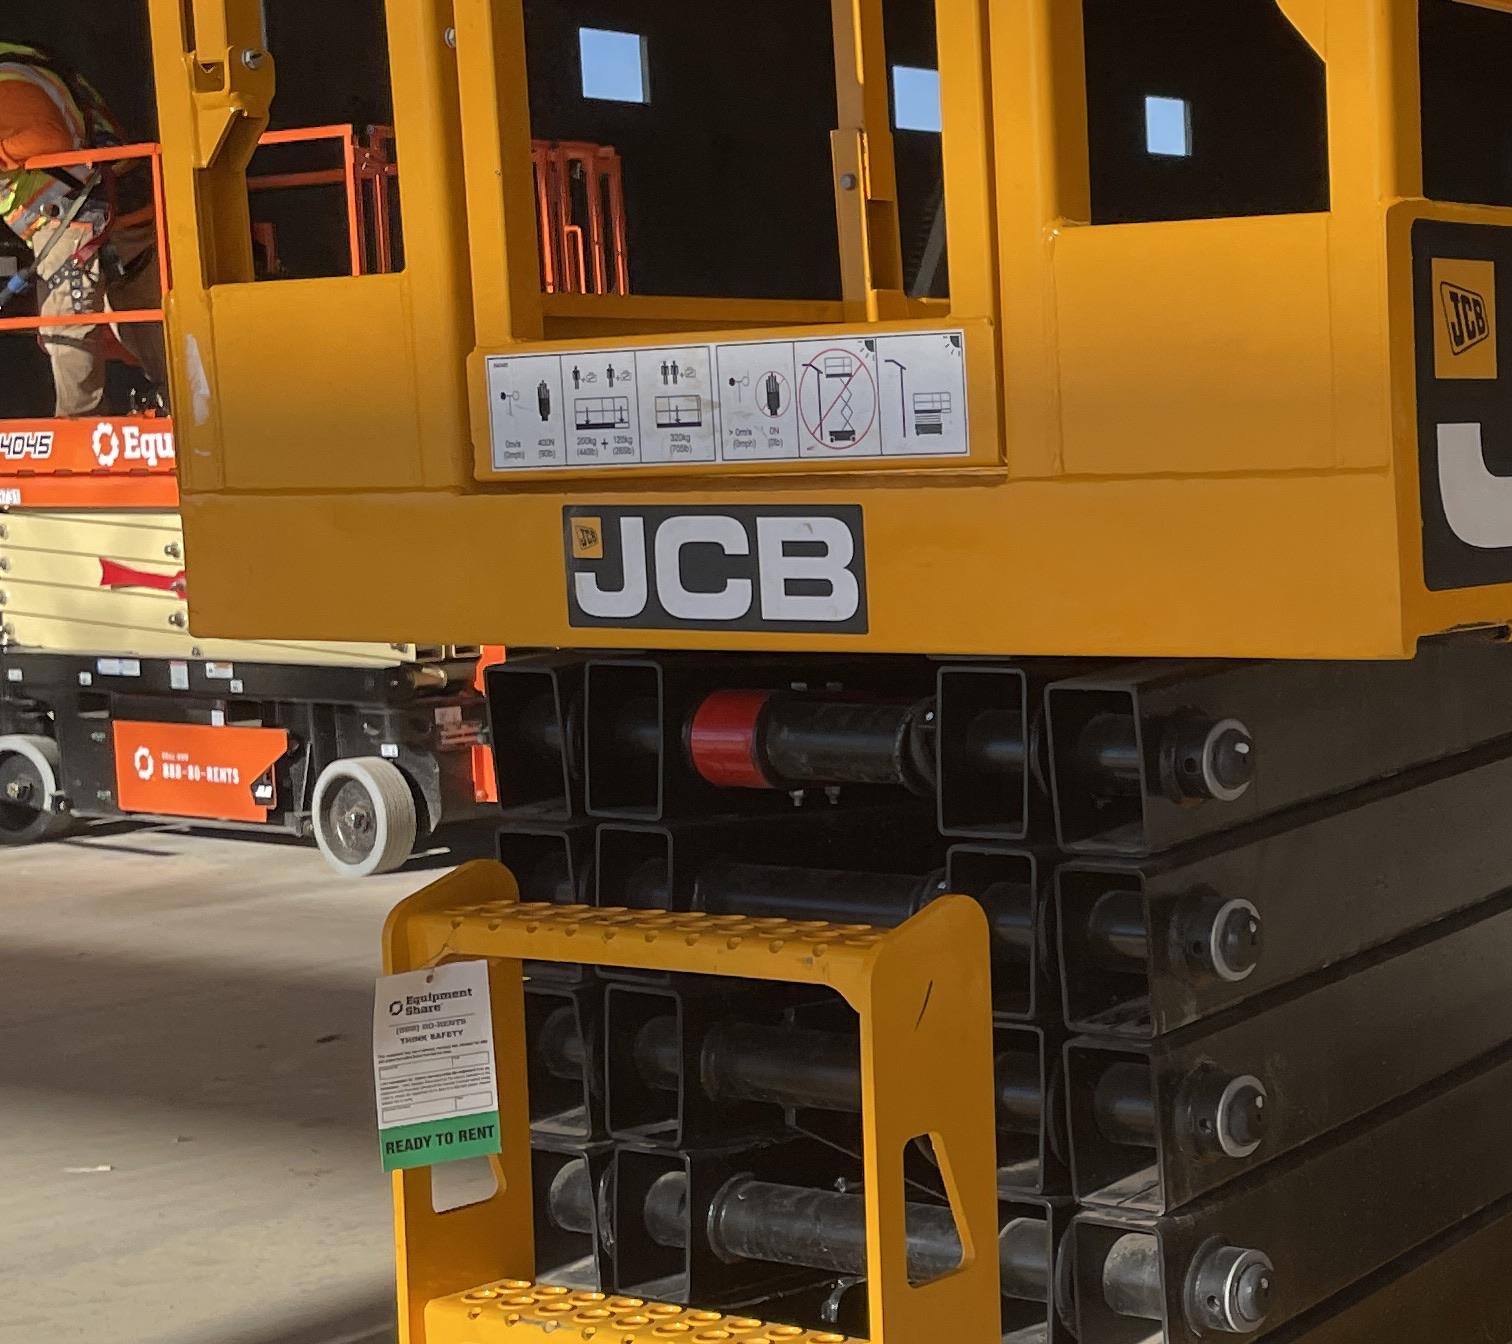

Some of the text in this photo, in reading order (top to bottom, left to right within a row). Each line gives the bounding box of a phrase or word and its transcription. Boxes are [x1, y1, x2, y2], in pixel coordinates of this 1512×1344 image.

[1448, 289, 1487, 348] JCB
[574, 515, 859, 622] JCB
[405, 988, 473, 1006] Equipment
[405, 1004, 442, 1016] Share
[385, 1124, 496, 1155] READY TO RENT
